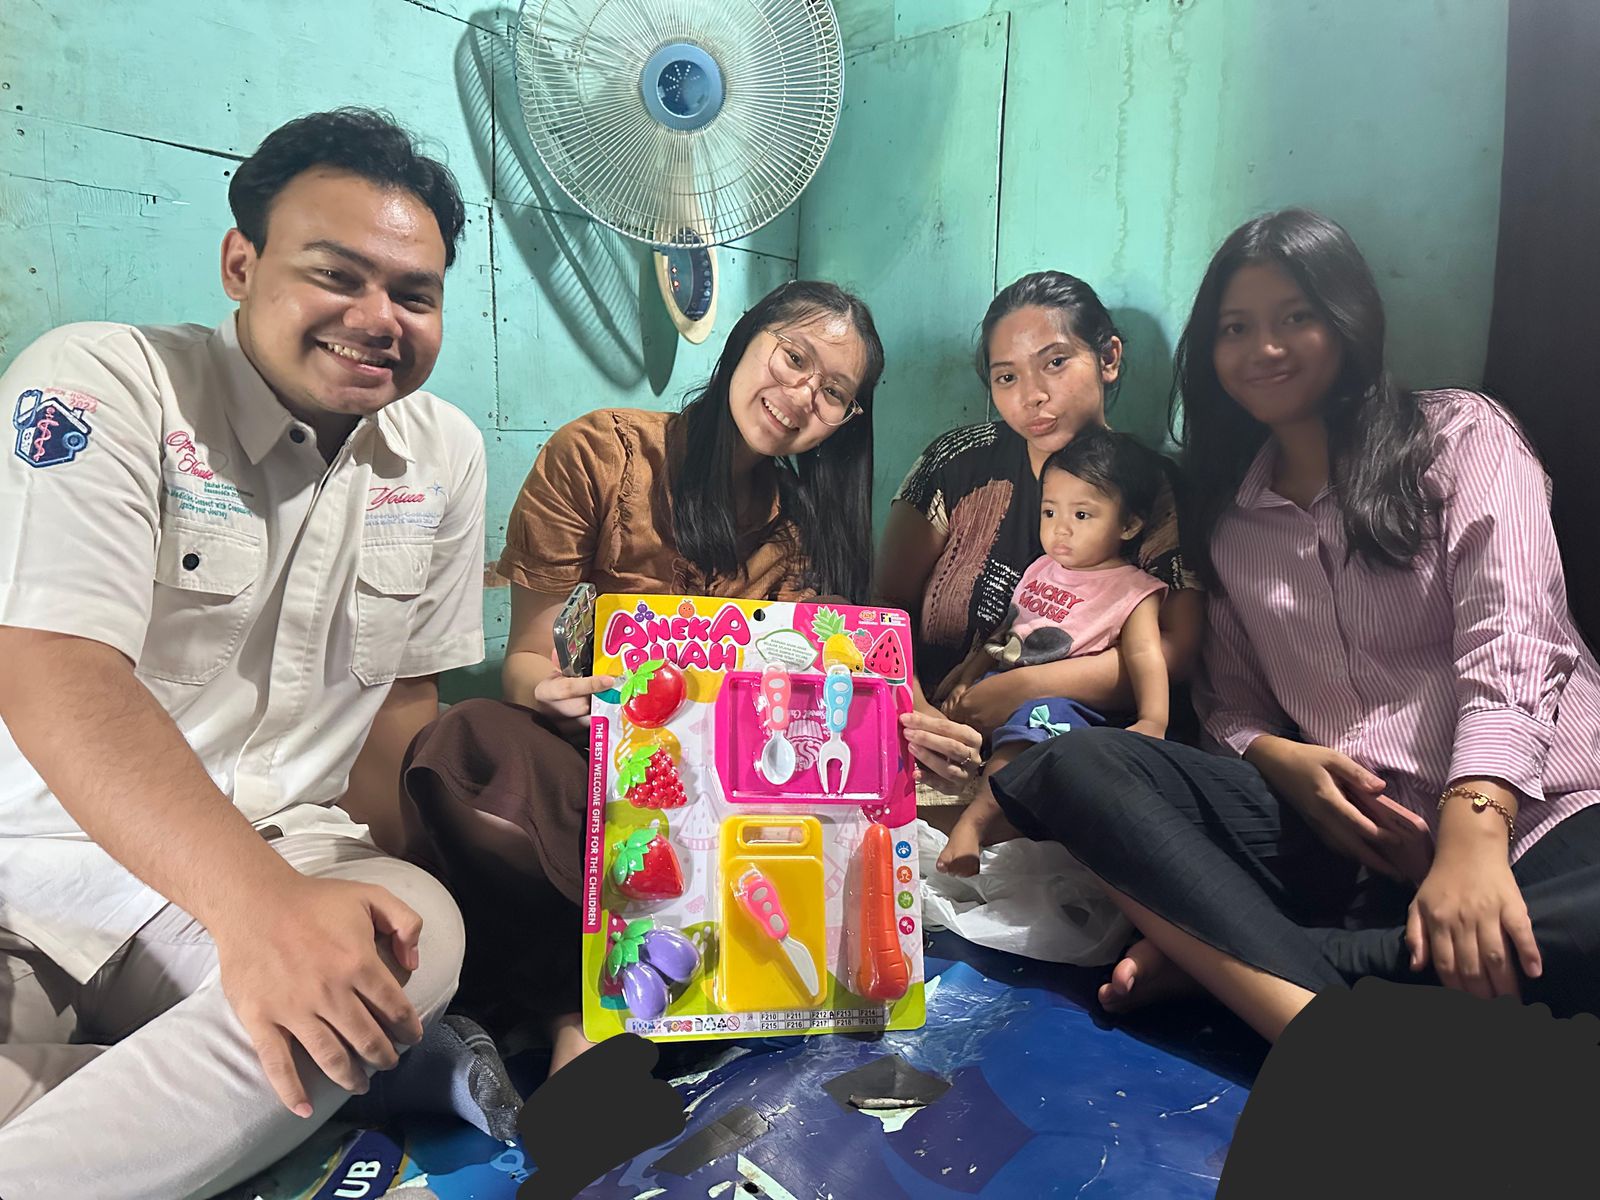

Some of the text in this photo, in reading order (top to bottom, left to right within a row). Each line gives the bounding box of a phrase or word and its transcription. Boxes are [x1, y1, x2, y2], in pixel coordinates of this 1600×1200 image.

[166, 431, 196, 455] Open
[178, 453, 214, 480] House
[1018, 591, 1070, 624] MOUSE
[1024, 579, 1085, 609] MICKEY
[605, 604, 751, 656] ANEKA
[588, 723, 604, 926] THE BEST WELCOME GIFTS FOR THE CHILIDREN
[663, 1020, 693, 1033] TOYS
[333, 1160, 381, 1198] UB
